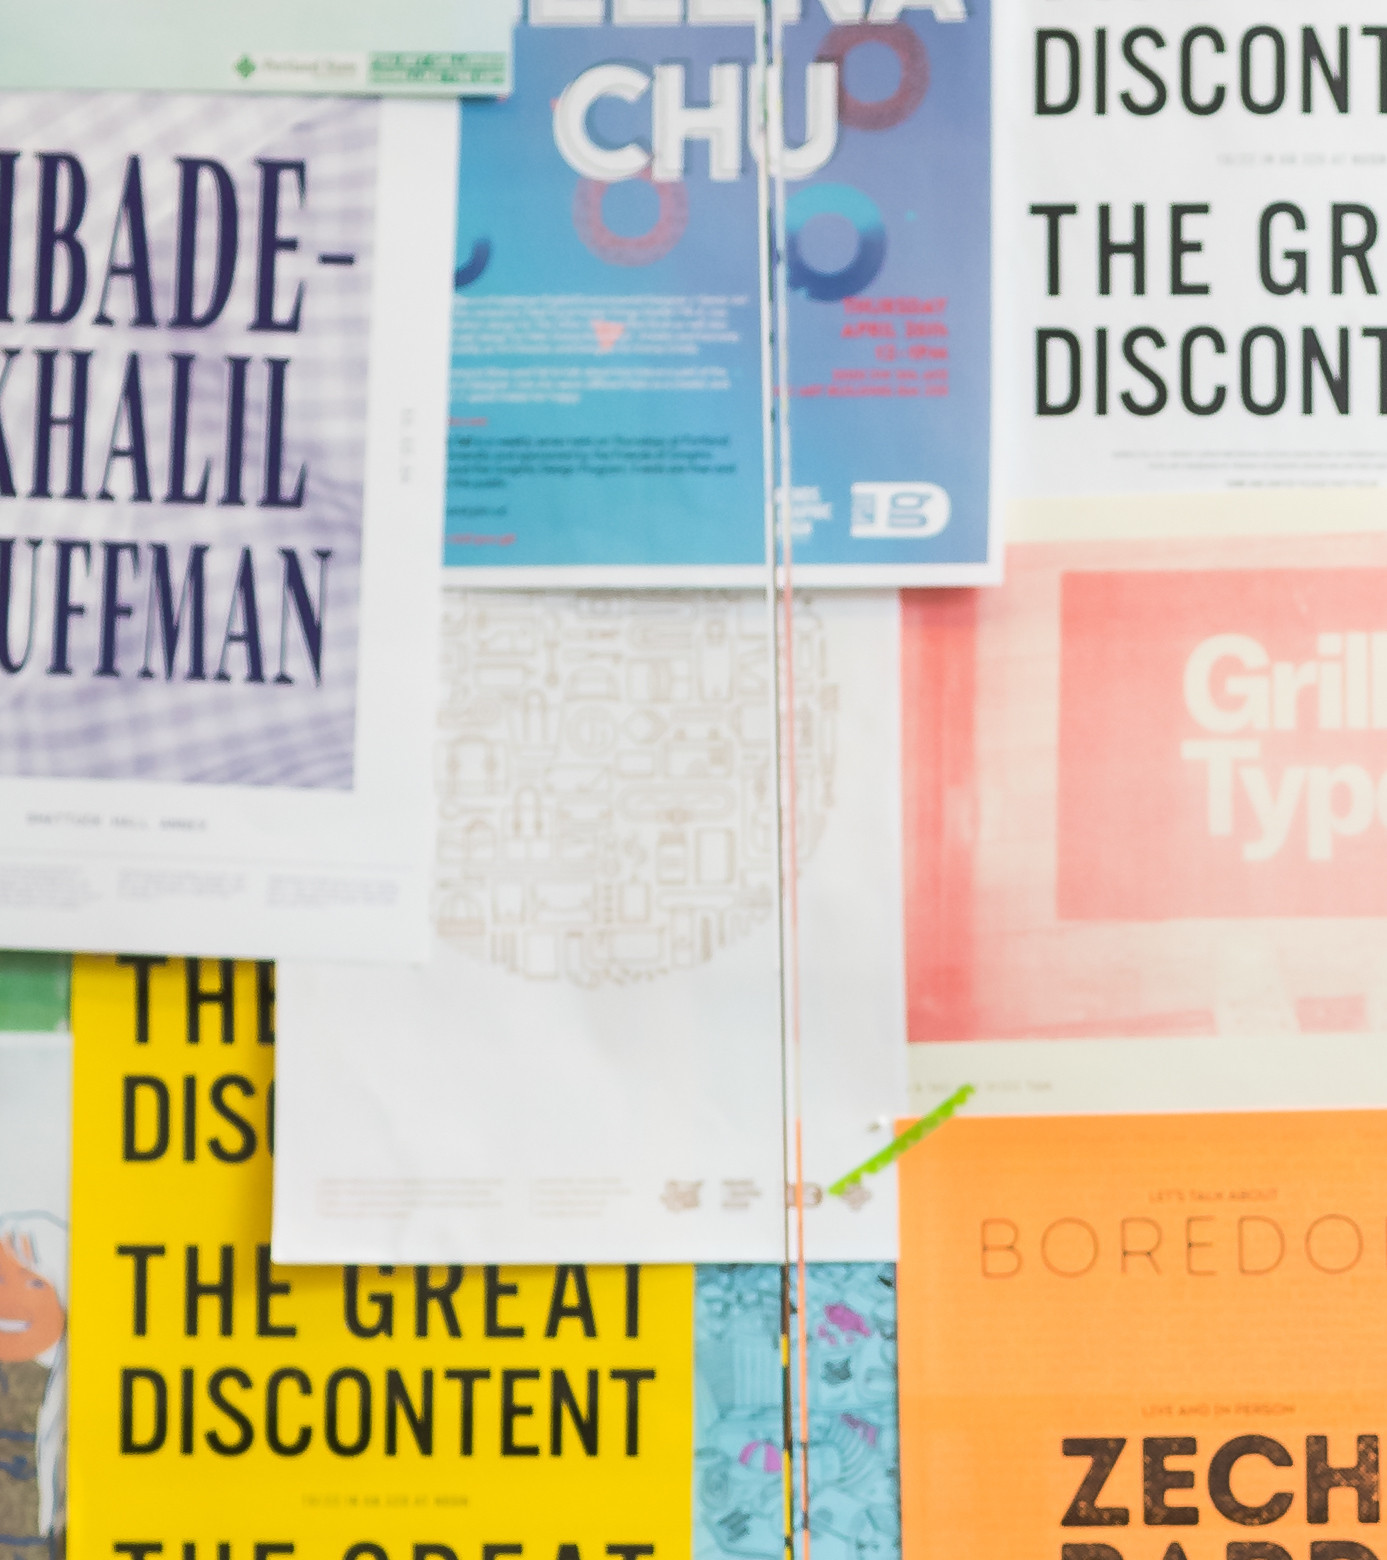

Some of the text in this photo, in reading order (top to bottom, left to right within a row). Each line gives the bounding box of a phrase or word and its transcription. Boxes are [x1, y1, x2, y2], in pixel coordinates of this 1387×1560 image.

[553, 60, 840, 182] CHU
[1031, 202, 1211, 296] THE
[117, 1244, 298, 1339] THE
[120, 1366, 657, 1459] DISCONTENT
[1060, 1432, 1382, 1528] ZECH
